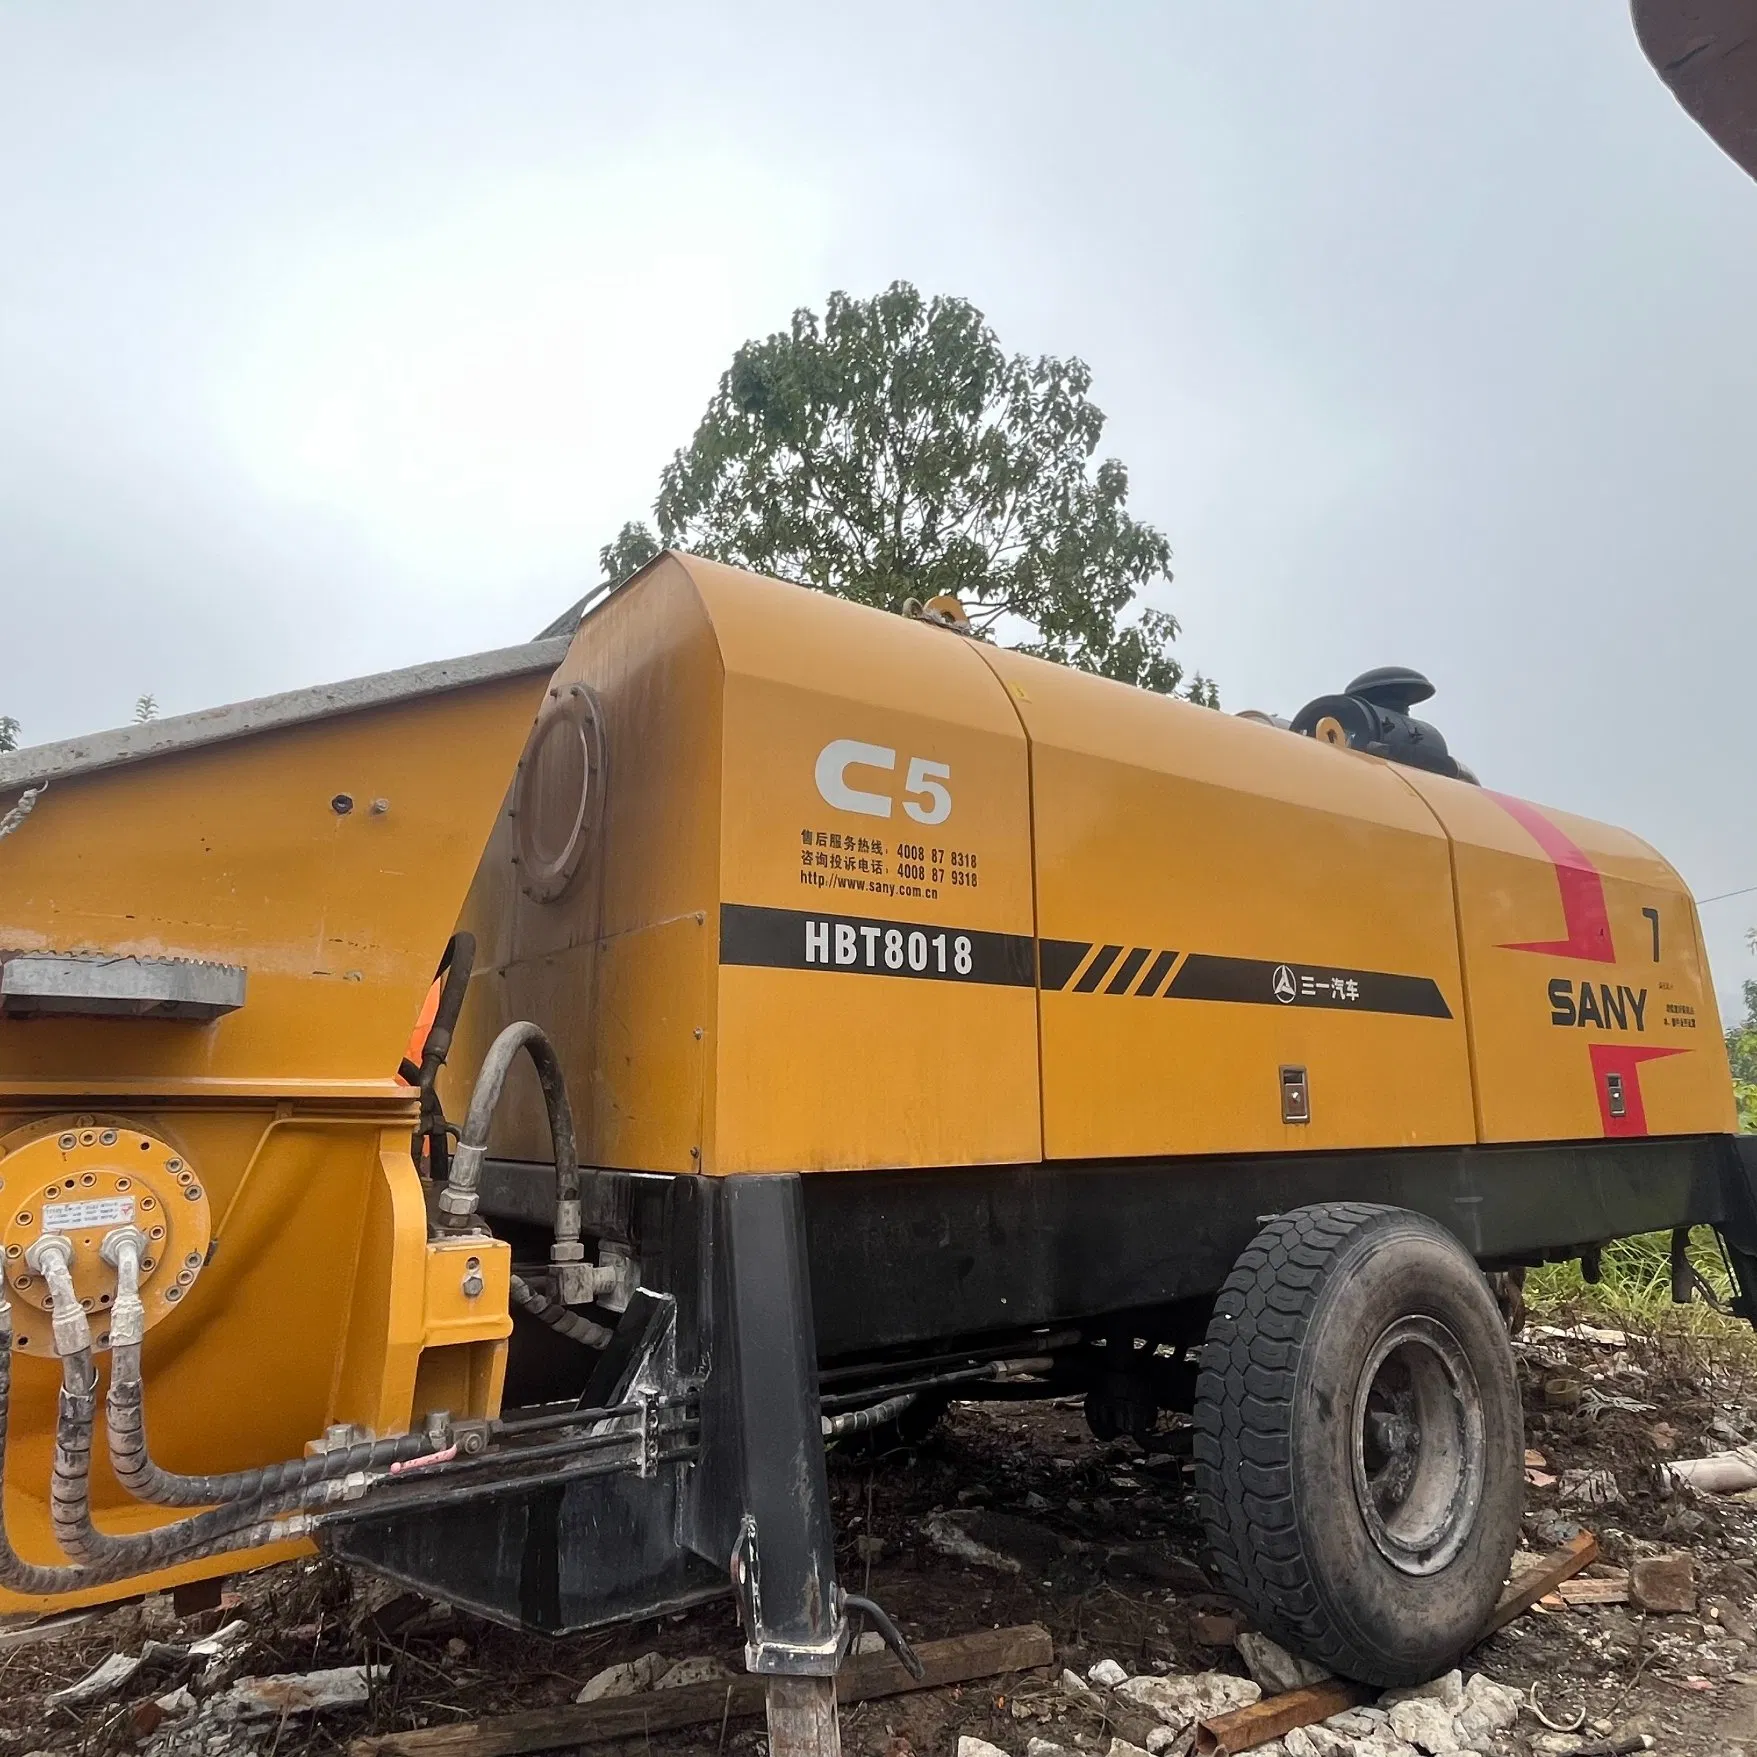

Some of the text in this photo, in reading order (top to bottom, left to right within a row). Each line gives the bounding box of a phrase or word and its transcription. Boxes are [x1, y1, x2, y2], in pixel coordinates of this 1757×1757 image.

[897, 844, 924, 861] 4008
[931, 849, 944, 864] 87
[951, 852, 977, 868] 8318
[800, 870, 938, 899] http://www.sany.com.cn
[897, 864, 924, 880] 4008
[932, 869, 944, 883] 87
[952, 871, 977, 887] 9318
[805, 920, 972, 975] HBT8018
[1301, 976, 1359, 1001] 三一汽车
[1548, 978, 1647, 1032] SANY
